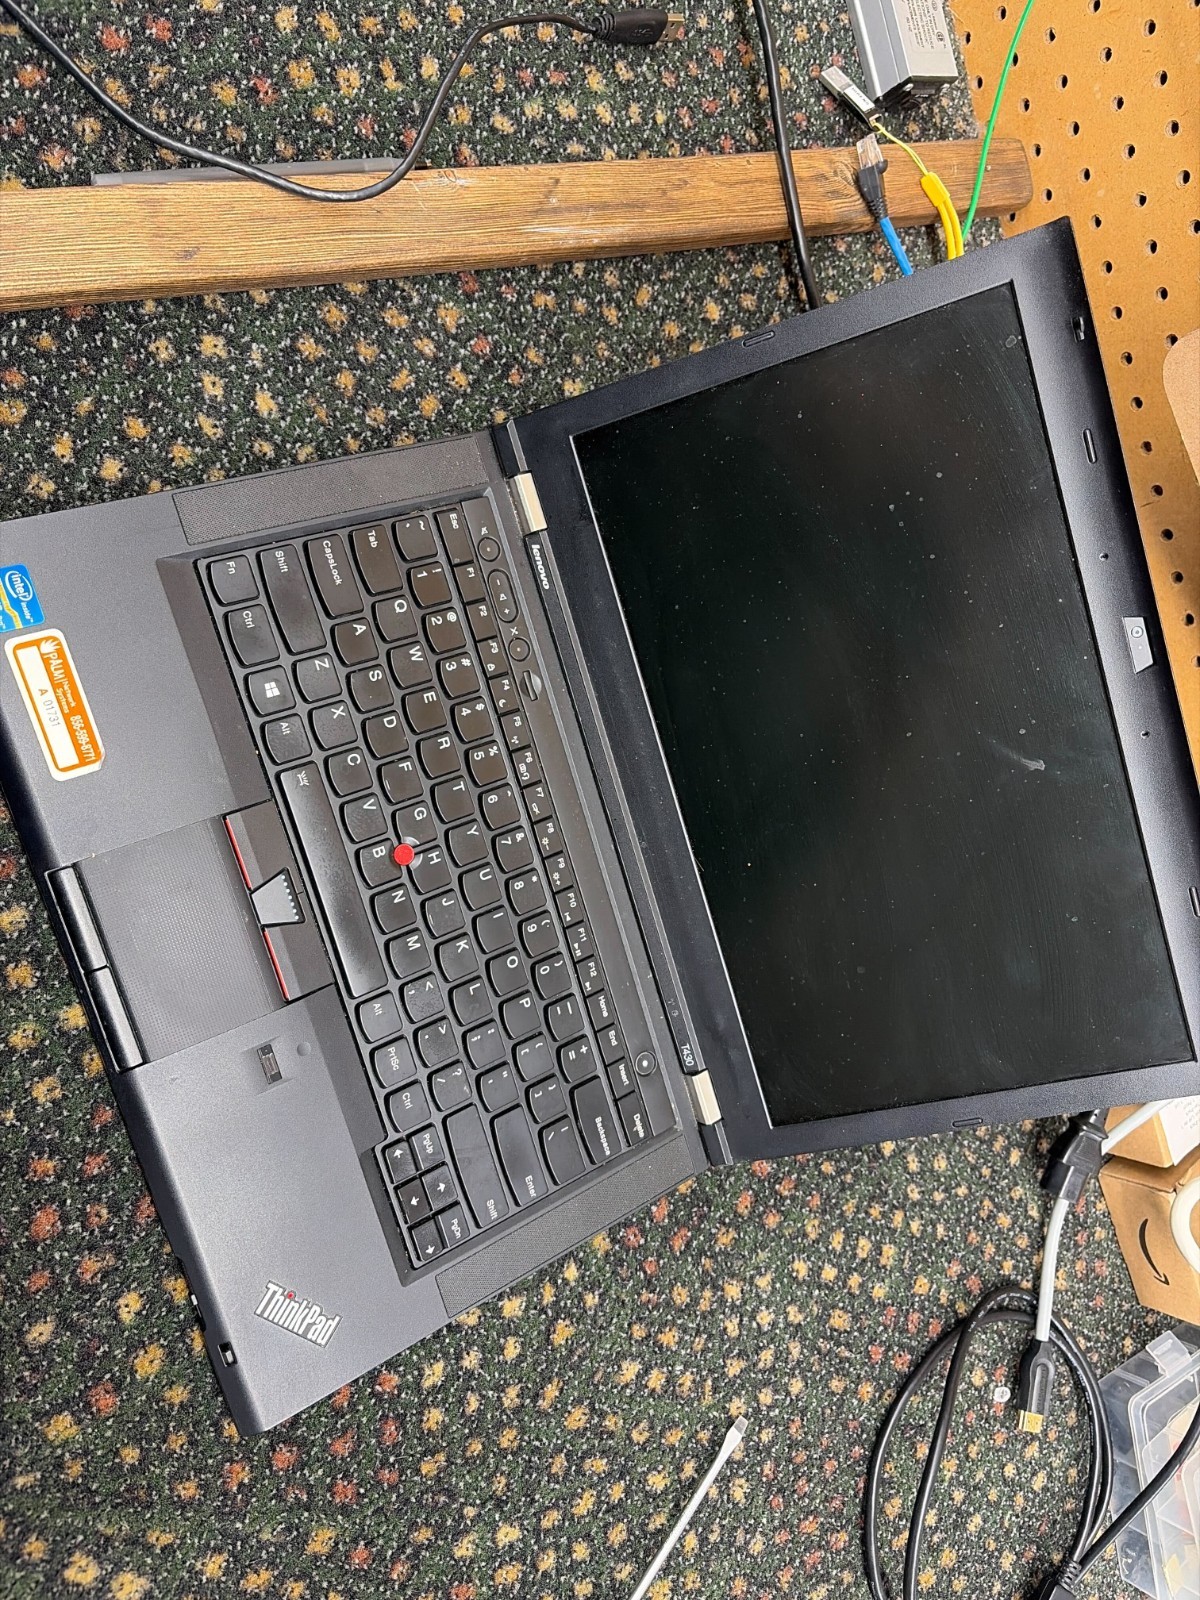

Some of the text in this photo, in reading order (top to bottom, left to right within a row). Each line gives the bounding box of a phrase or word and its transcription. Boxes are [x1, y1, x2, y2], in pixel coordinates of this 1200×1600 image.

[450, 514, 458, 529] Esc
[368, 530, 378, 547] Tab
[275, 551, 288, 572] Shift
[323, 541, 342, 585] CapsLock
[532, 544, 550, 590] lenovo
[227, 562, 235, 574] Fn
[467, 568, 475, 577] F1
[11, 573, 29, 598] intel
[395, 600, 407, 613] Q
[479, 606, 487, 616] F2
[243, 611, 255, 628] Ctrl
[431, 616, 442, 625] 2
[353, 624, 366, 635] A
[409, 646, 423, 660] W
[489, 641, 498, 653] F3
[43, 652, 65, 681] PALM
[315, 658, 329, 670] Z
[446, 662, 456, 670] 3
[369, 670, 382, 681] S
[502, 680, 510, 690] F4
[61, 680, 77, 708] Network
[424, 692, 436, 703] E
[55, 687, 70, 714] Systems
[38, 688, 61, 727] A 01731
[331, 706, 345, 718] X
[462, 708, 471, 716] 4
[384, 716, 396, 727] D
[514, 716, 521, 726] F5
[280, 723, 290, 734] Alt
[69, 714, 97, 763] 856-599-8771
[438, 737, 450, 749] R
[348, 754, 360, 765] C
[474, 752, 484, 760] 5
[525, 752, 532, 763] F6
[399, 762, 412, 771] F
[453, 781, 465, 791] T
[536, 787, 544, 797] F7
[363, 799, 376, 809] V
[488, 795, 498, 803] 6
[414, 808, 426, 820] G
[467, 825, 479, 835] Y
[547, 823, 554, 833] F8
[373, 846, 385, 857] B
[428, 852, 441, 864] H
[558, 858, 565, 868] F9
[480, 869, 492, 880] U
[514, 881, 524, 890] 8
[392, 890, 405, 903] N
[568, 893, 576, 907] F10
[528, 924, 537, 932] 9
[578, 928, 587, 941] F11
[407, 935, 420, 950] M
[456, 940, 469, 952] K
[507, 956, 518, 968] O
[540, 966, 549, 974] 0
[588, 962, 597, 977] F12
[470, 983, 480, 995] L
[520, 998, 530, 1007] P
[599, 996, 608, 1017] Home
[373, 1004, 382, 1015] Alt
[609, 1030, 617, 1046] End
[388, 1047, 399, 1070] PrtSc
[681, 1043, 694, 1067] T430
[619, 1064, 629, 1085] Insert
[403, 1093, 413, 1109] Ctrl
[633, 1114, 644, 1137] Delete
[595, 1117, 610, 1155] Backspace
[423, 1133, 433, 1153] PgUp
[526, 1175, 536, 1197] Enter
[487, 1200, 497, 1219] Shift
[451, 1218, 461, 1238] PgDn
[254, 1280, 342, 1348] ThinkPad
